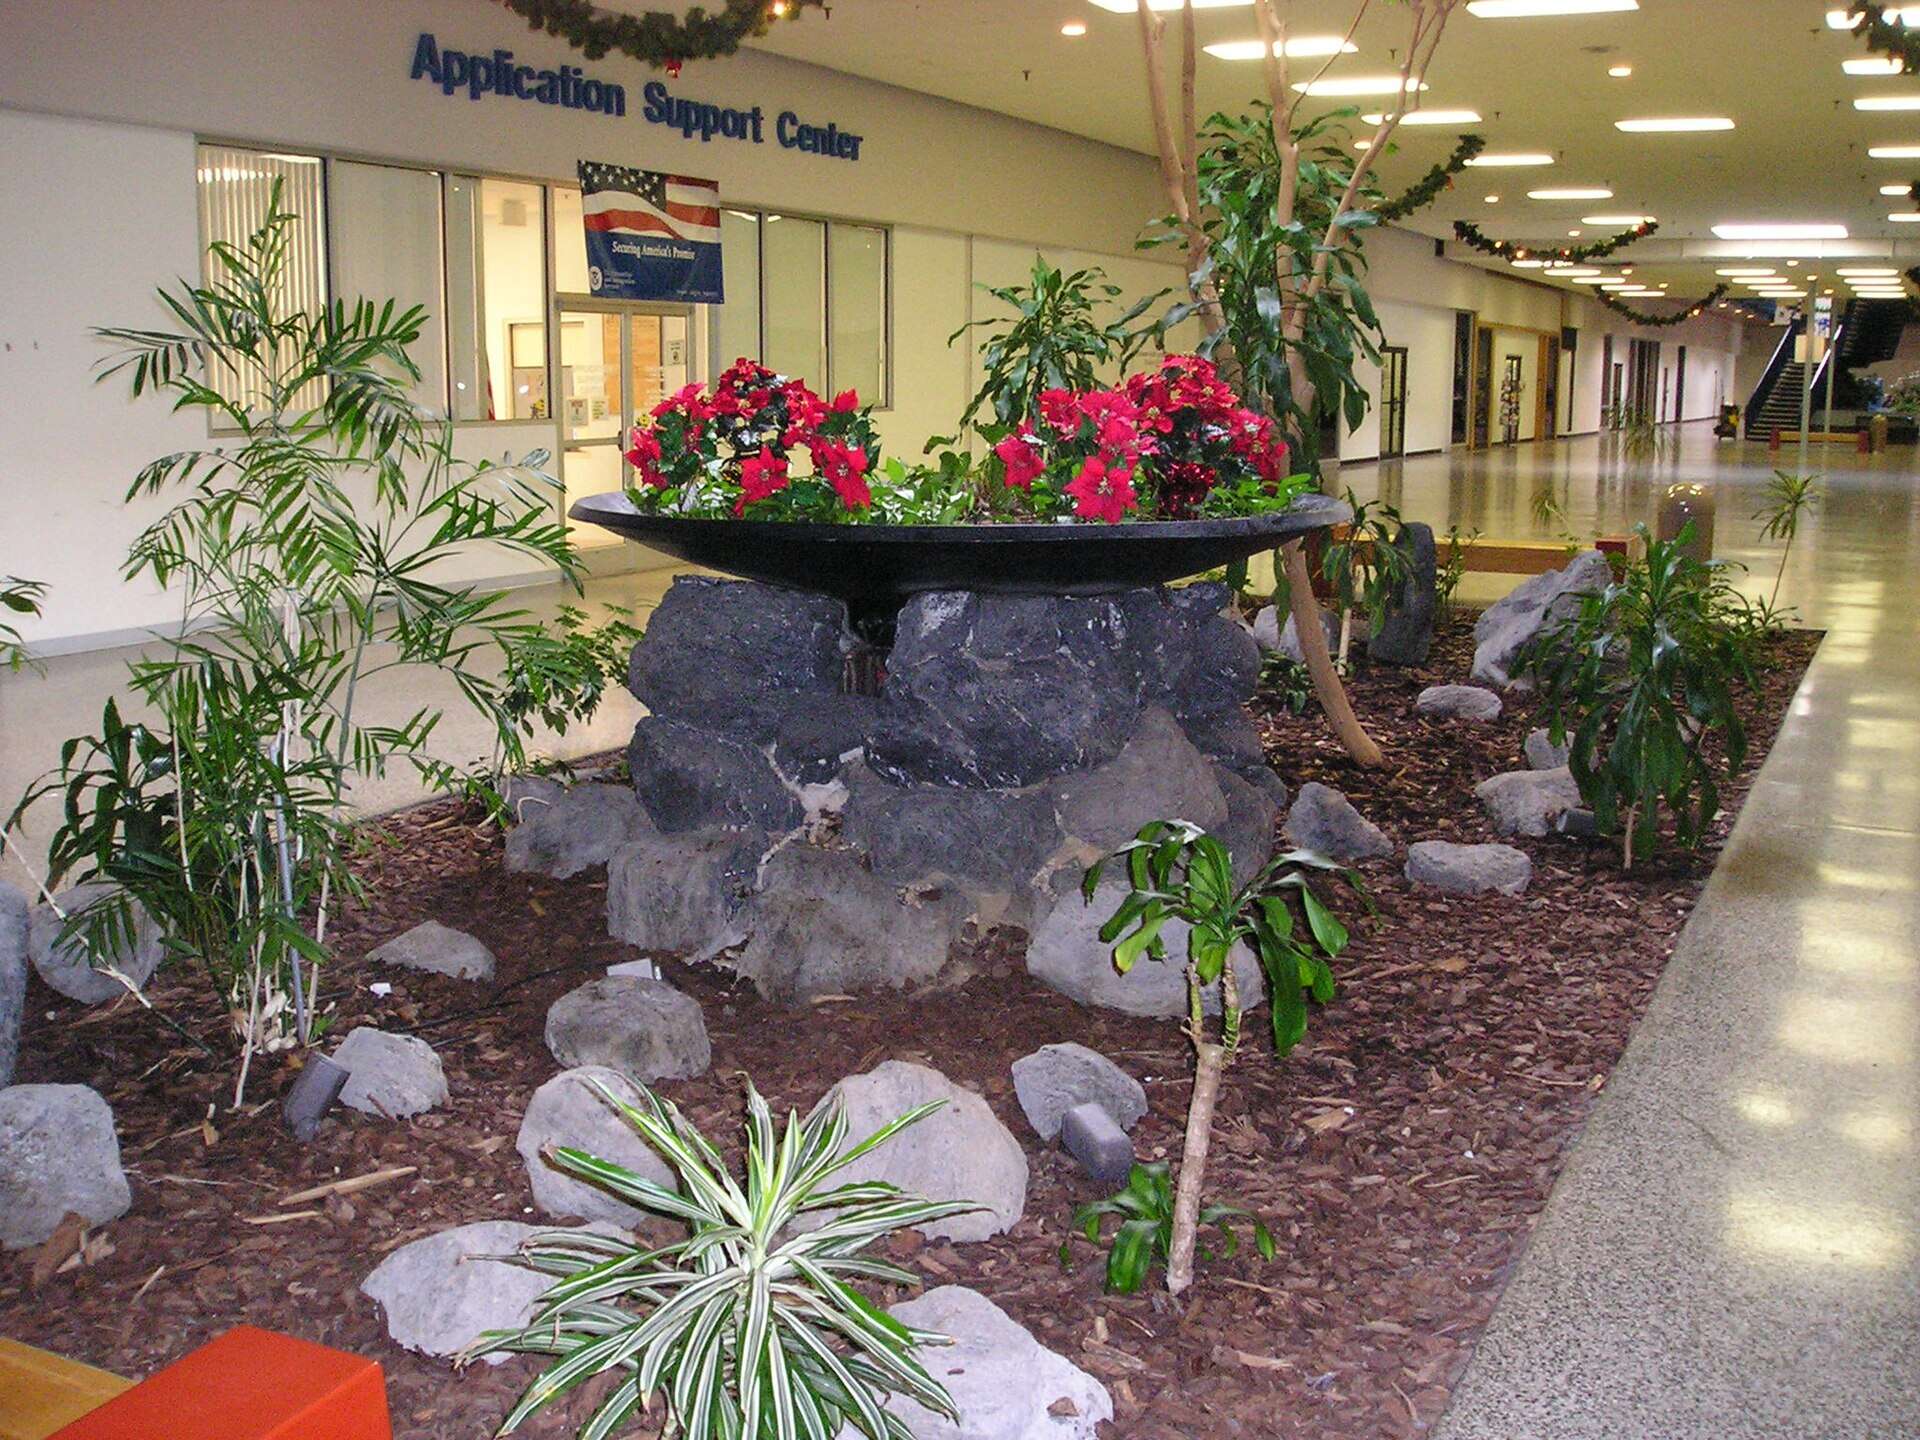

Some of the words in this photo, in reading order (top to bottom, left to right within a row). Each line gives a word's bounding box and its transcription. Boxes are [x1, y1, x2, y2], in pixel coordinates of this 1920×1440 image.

[410, 33, 625, 116] Application
[643, 81, 764, 143] Support
[777, 112, 863, 160] Center
[612, 241, 640, 258] Securing
[641, 244, 671, 258] America's
[673, 246, 695, 260] Promise
